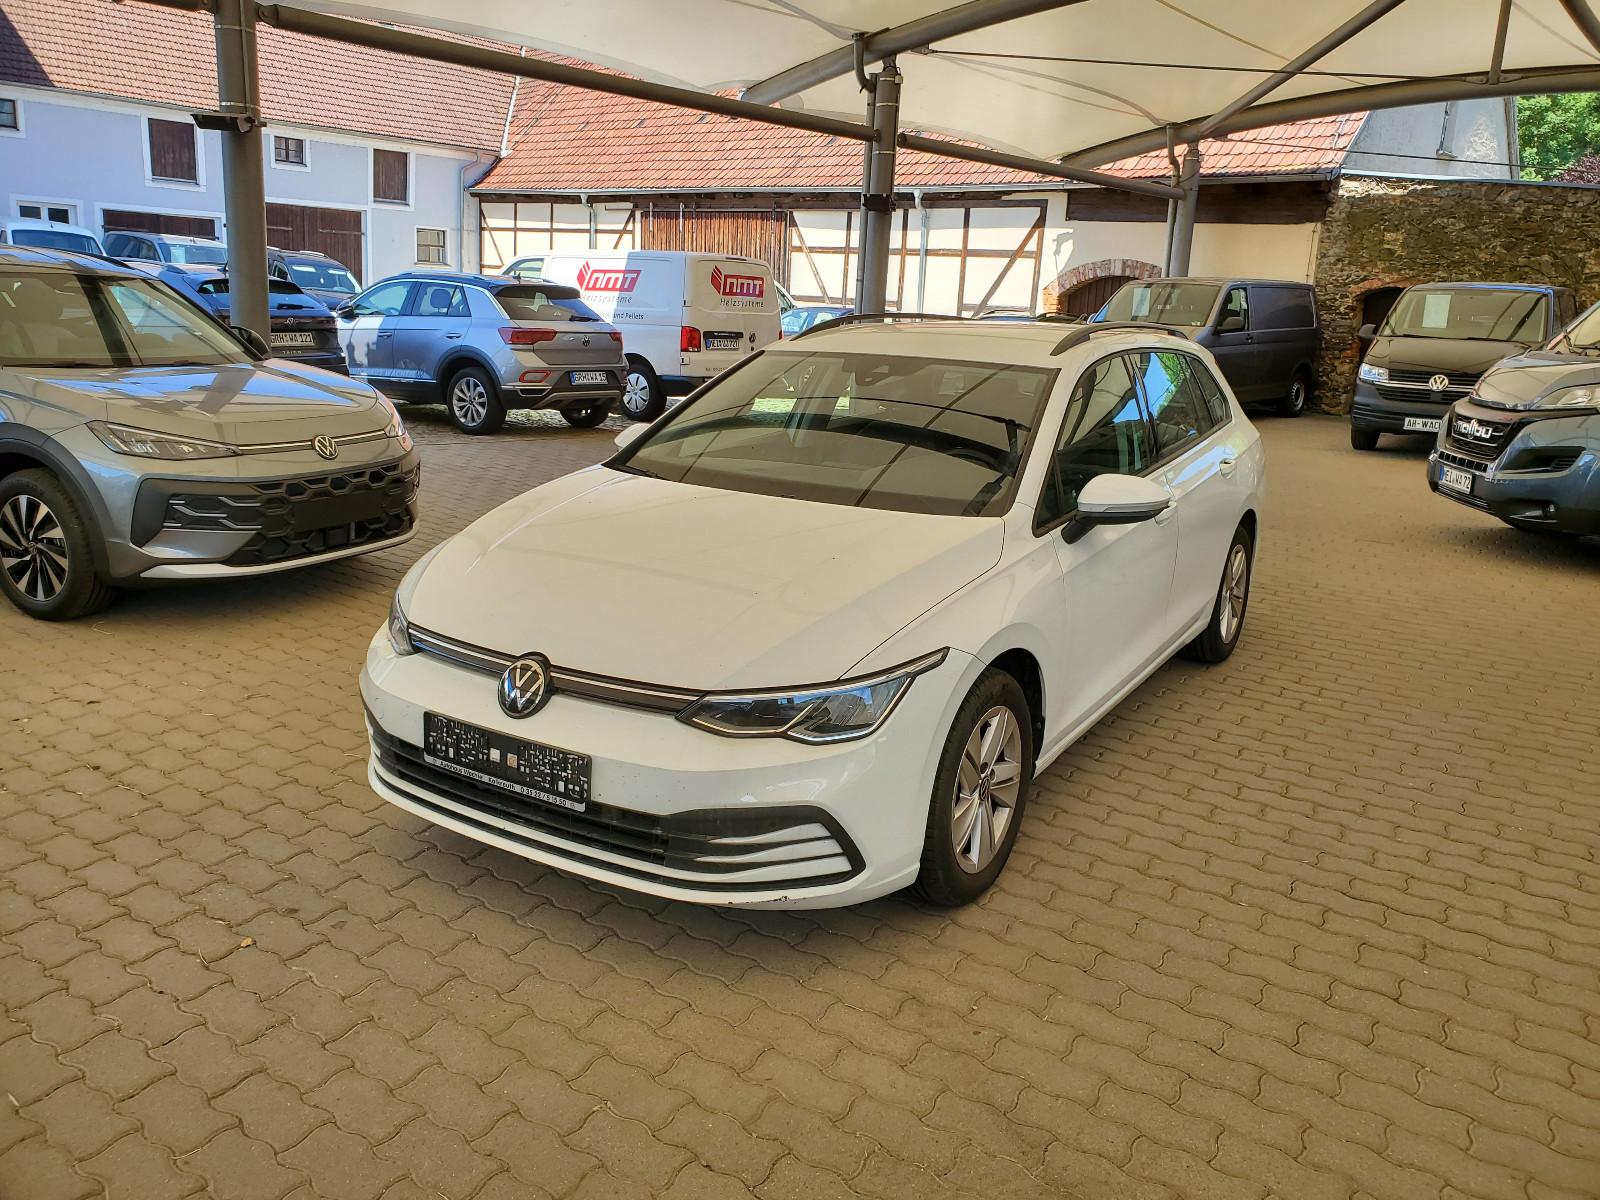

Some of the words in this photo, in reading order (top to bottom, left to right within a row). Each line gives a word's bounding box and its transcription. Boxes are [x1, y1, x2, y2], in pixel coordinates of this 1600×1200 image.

[720, 298, 764, 309] Heizsysteme
[299, 333, 313, 343] 121
[1463, 475, 1471, 490] 72
